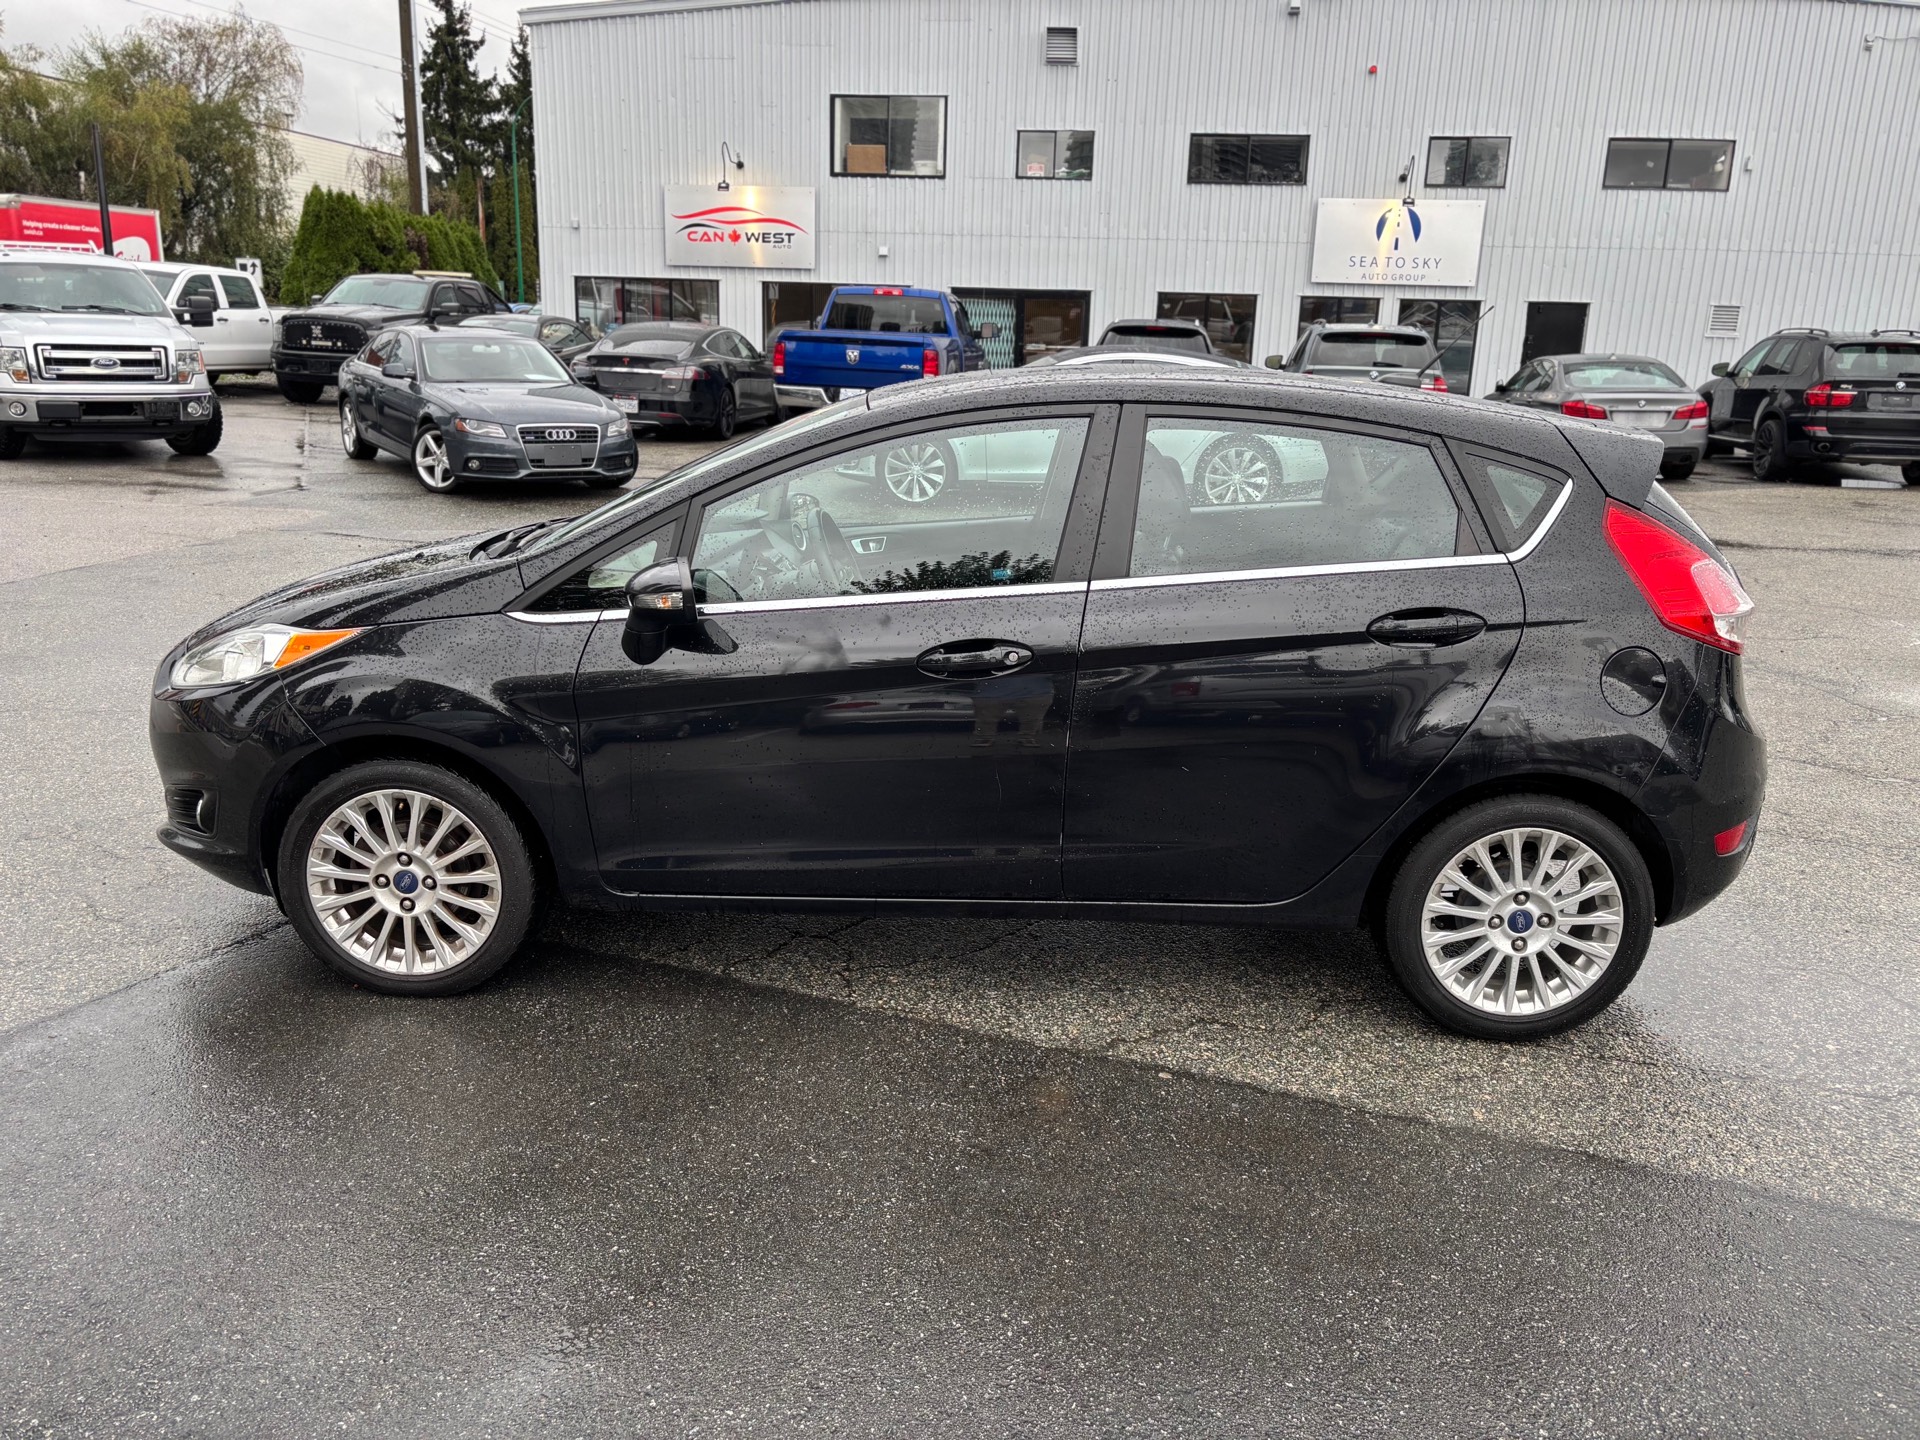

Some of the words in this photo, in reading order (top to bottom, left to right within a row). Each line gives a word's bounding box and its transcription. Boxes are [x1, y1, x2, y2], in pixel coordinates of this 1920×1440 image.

[22, 219, 43, 229] Helping
[63, 223, 81, 231] cleaner
[687, 230, 724, 243] CAN
[744, 232, 796, 244] WEST
[1348, 255, 1379, 268] SEA
[1385, 256, 1405, 268] TO
[1412, 256, 1442, 269] SKY
[1361, 272, 1388, 281] AUTO
[1391, 273, 1426, 282] GROUP
